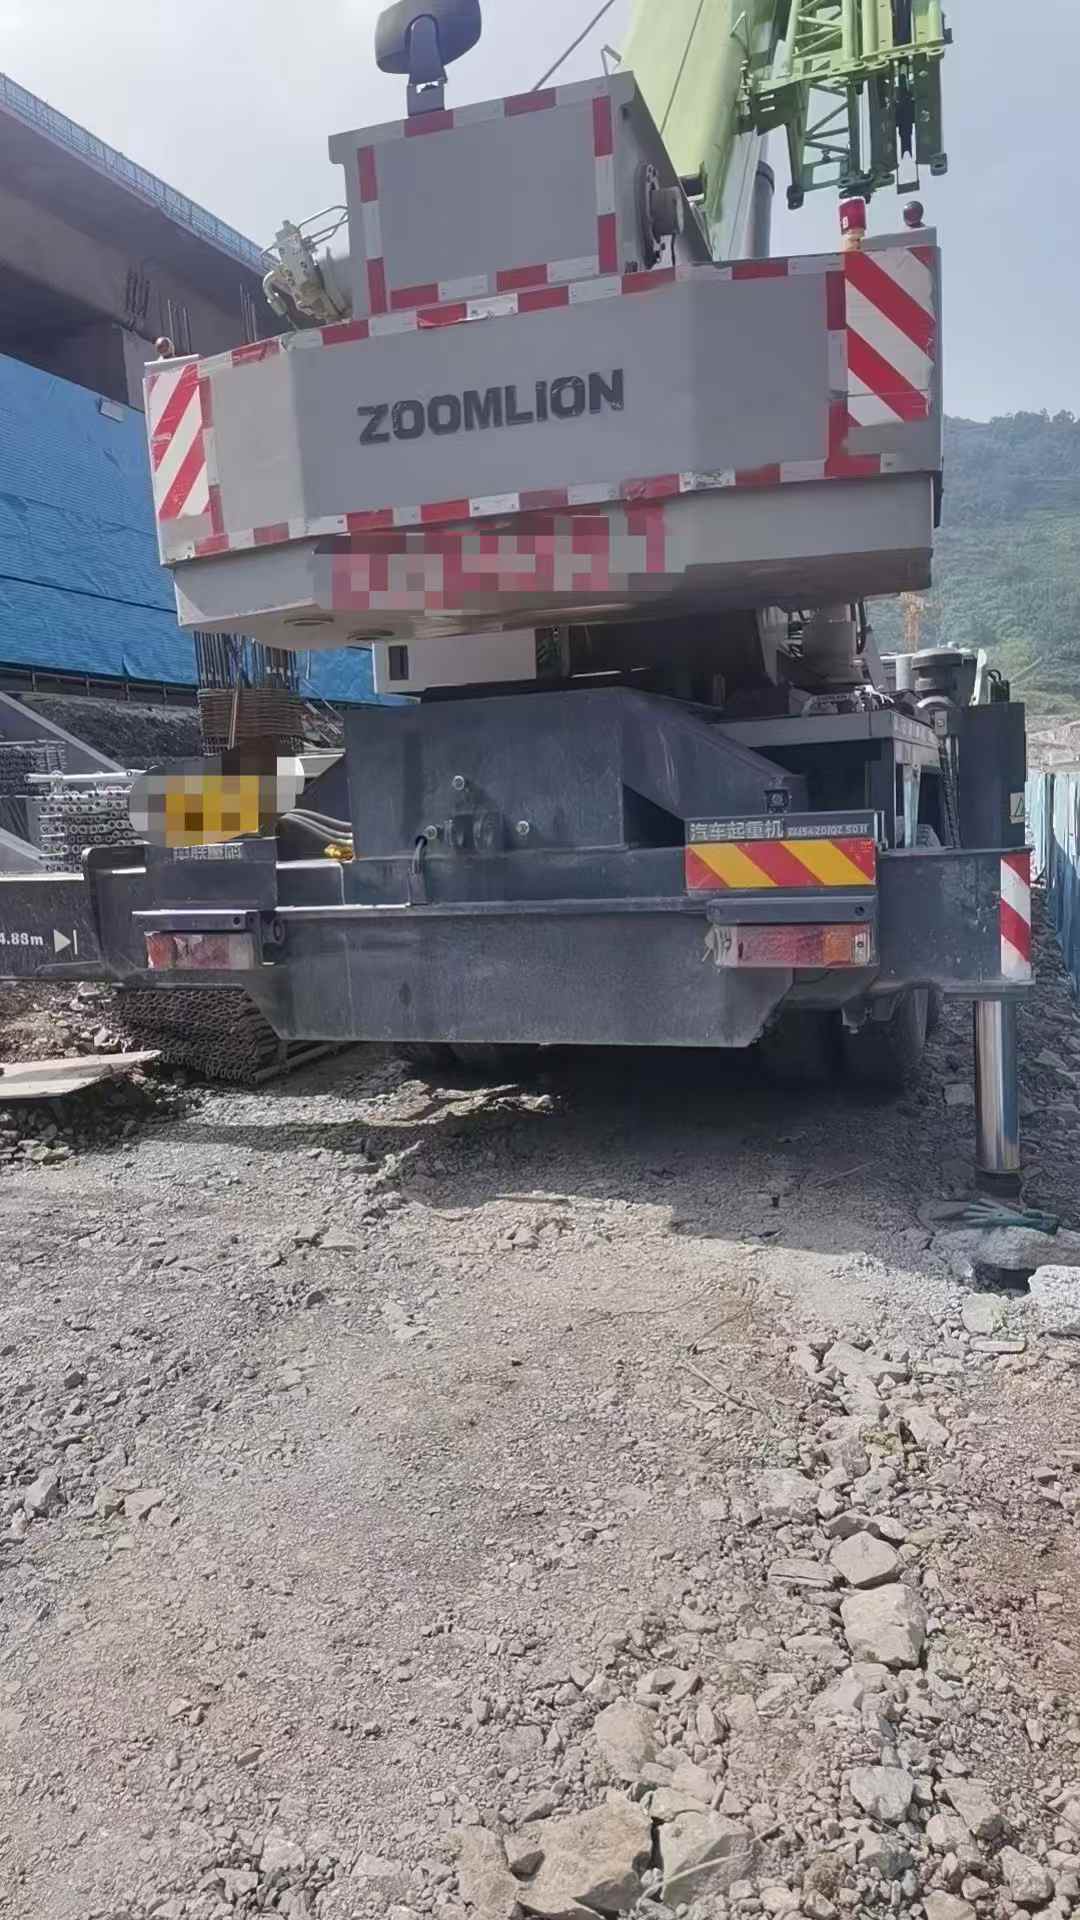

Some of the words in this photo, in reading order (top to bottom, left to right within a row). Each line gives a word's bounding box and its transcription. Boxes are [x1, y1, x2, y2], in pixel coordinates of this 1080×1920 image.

[356, 368, 625, 446] ZOOMLION
[689, 820, 784, 840] 汽车起重机
